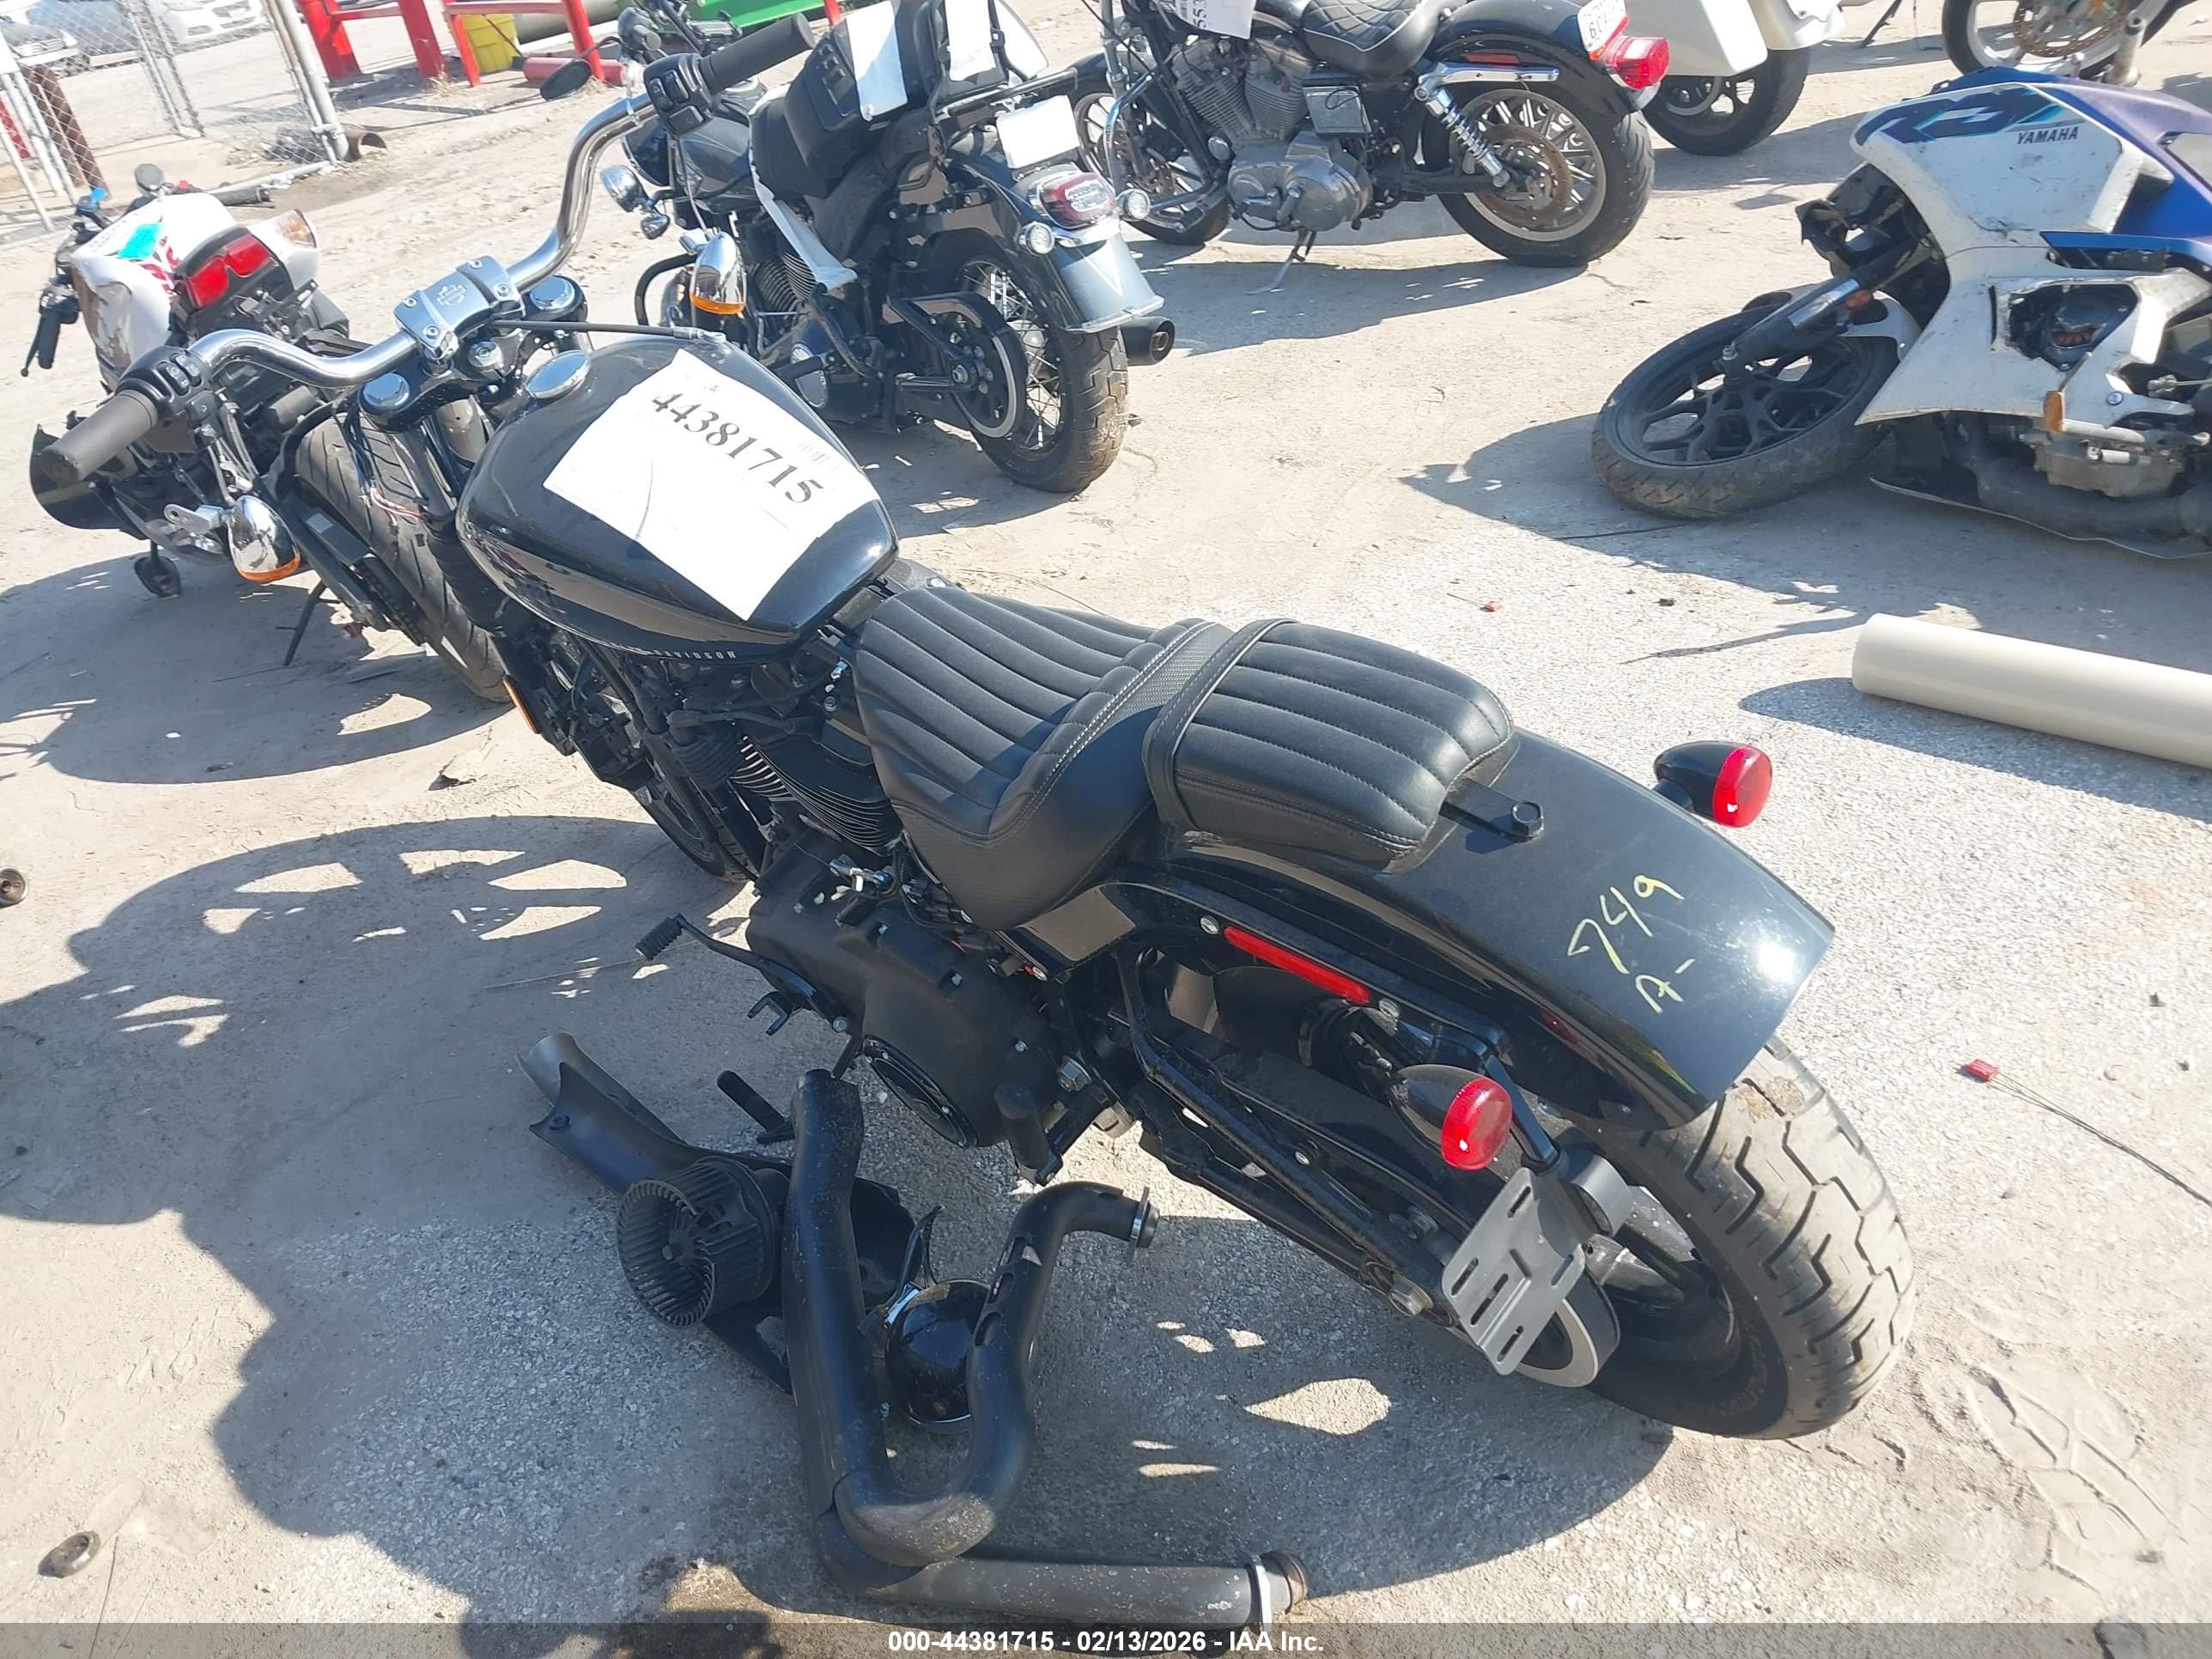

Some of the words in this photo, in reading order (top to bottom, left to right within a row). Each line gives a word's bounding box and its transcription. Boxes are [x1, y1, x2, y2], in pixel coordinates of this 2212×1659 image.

[2018, 126, 2079, 145] YAMAHA
[652, 392, 824, 503] 44381715
[1567, 874, 1686, 975] 749
